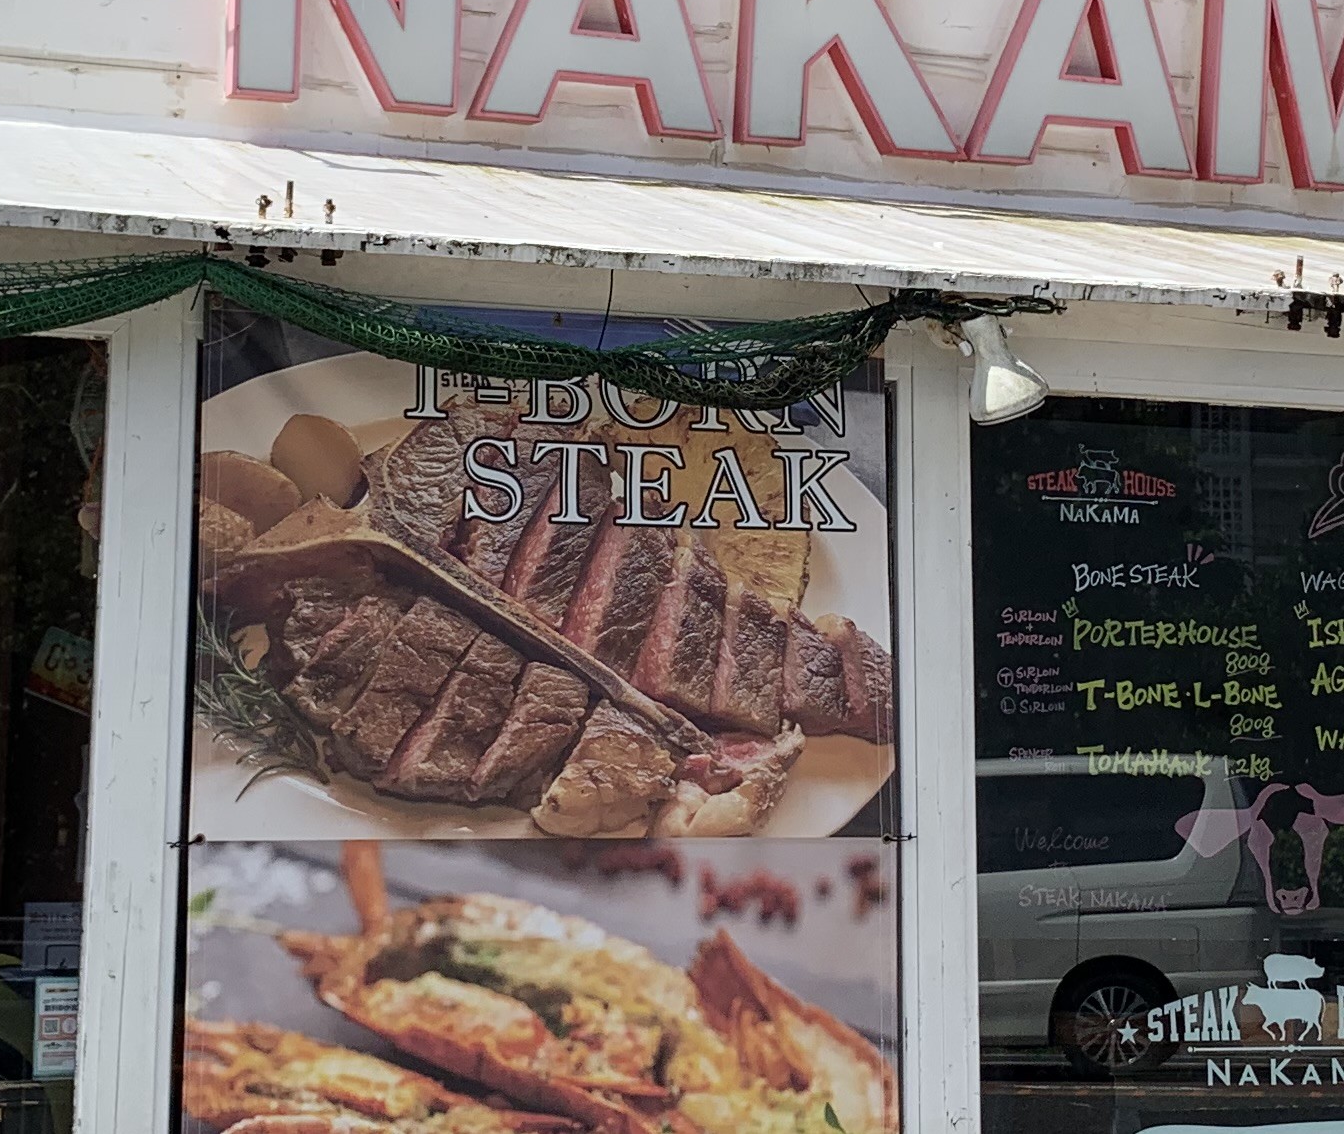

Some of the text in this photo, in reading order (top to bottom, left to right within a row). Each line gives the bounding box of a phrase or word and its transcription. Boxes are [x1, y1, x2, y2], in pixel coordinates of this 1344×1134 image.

[463, 436, 857, 532] STEAK
[1026, 467, 1177, 498] STEAK HOUSE
[1071, 561, 1201, 593] BONE STEAK
[1000, 606, 1058, 624] SIRLOIN
[996, 631, 1064, 647] TENDERLOIN
[1072, 616, 1262, 652] PORTERHOUSE
[1224, 651, 1274, 675] 800g
[1229, 712, 1276, 738] 800g
[1222, 752, 1274, 783] 1.2kg
[1014, 826, 1110, 853] Welcome
[1018, 884, 1083, 908] STEAK
[1147, 985, 1242, 1044] STEAK
